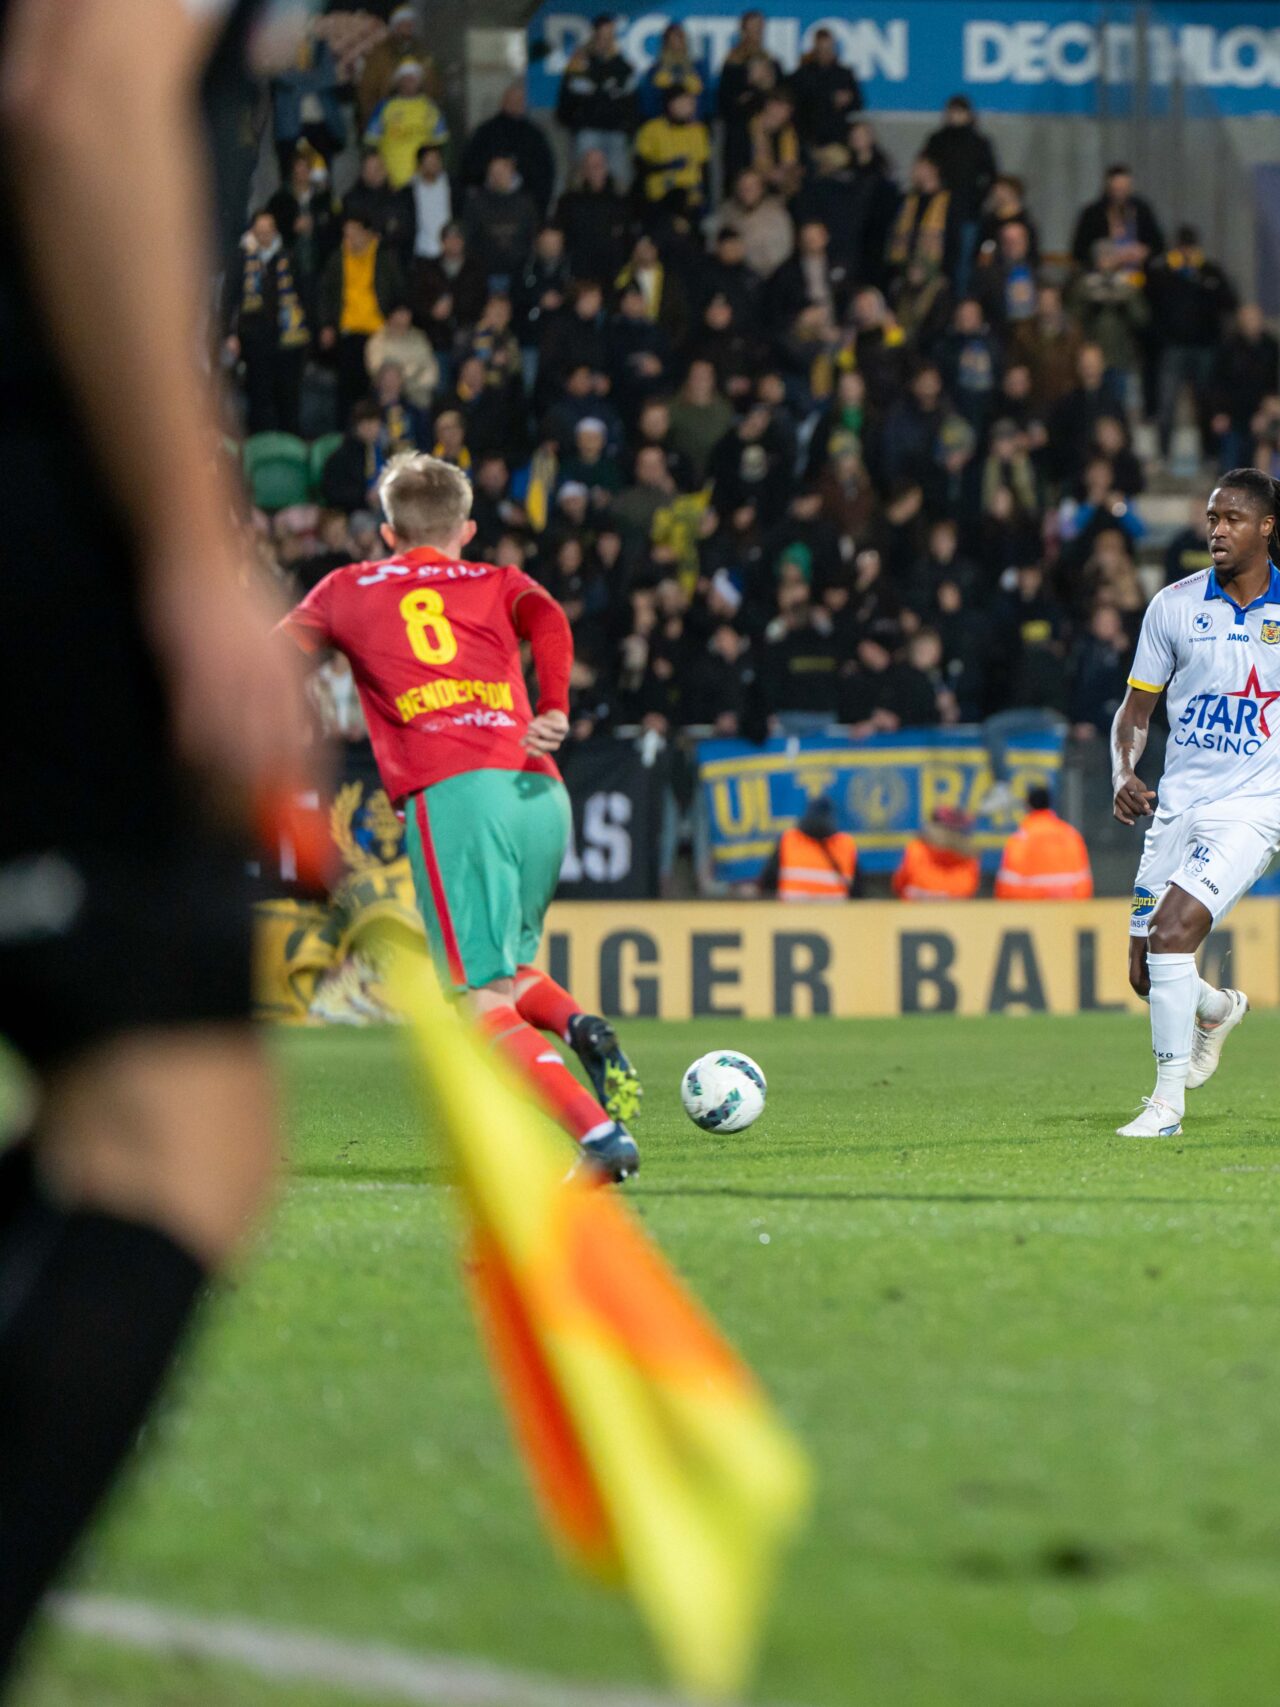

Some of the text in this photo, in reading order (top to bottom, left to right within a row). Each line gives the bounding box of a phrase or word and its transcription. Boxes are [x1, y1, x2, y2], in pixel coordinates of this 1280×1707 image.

[399, 588, 458, 665] 8
[1226, 633, 1250, 643] JAKO
[1178, 694, 1259, 737] STAR
[1174, 727, 1263, 756] CASINO
[1200, 877, 1219, 895] JAKO
[547, 927, 832, 1017] IGER
[1152, 1048, 1174, 1059] AKO
